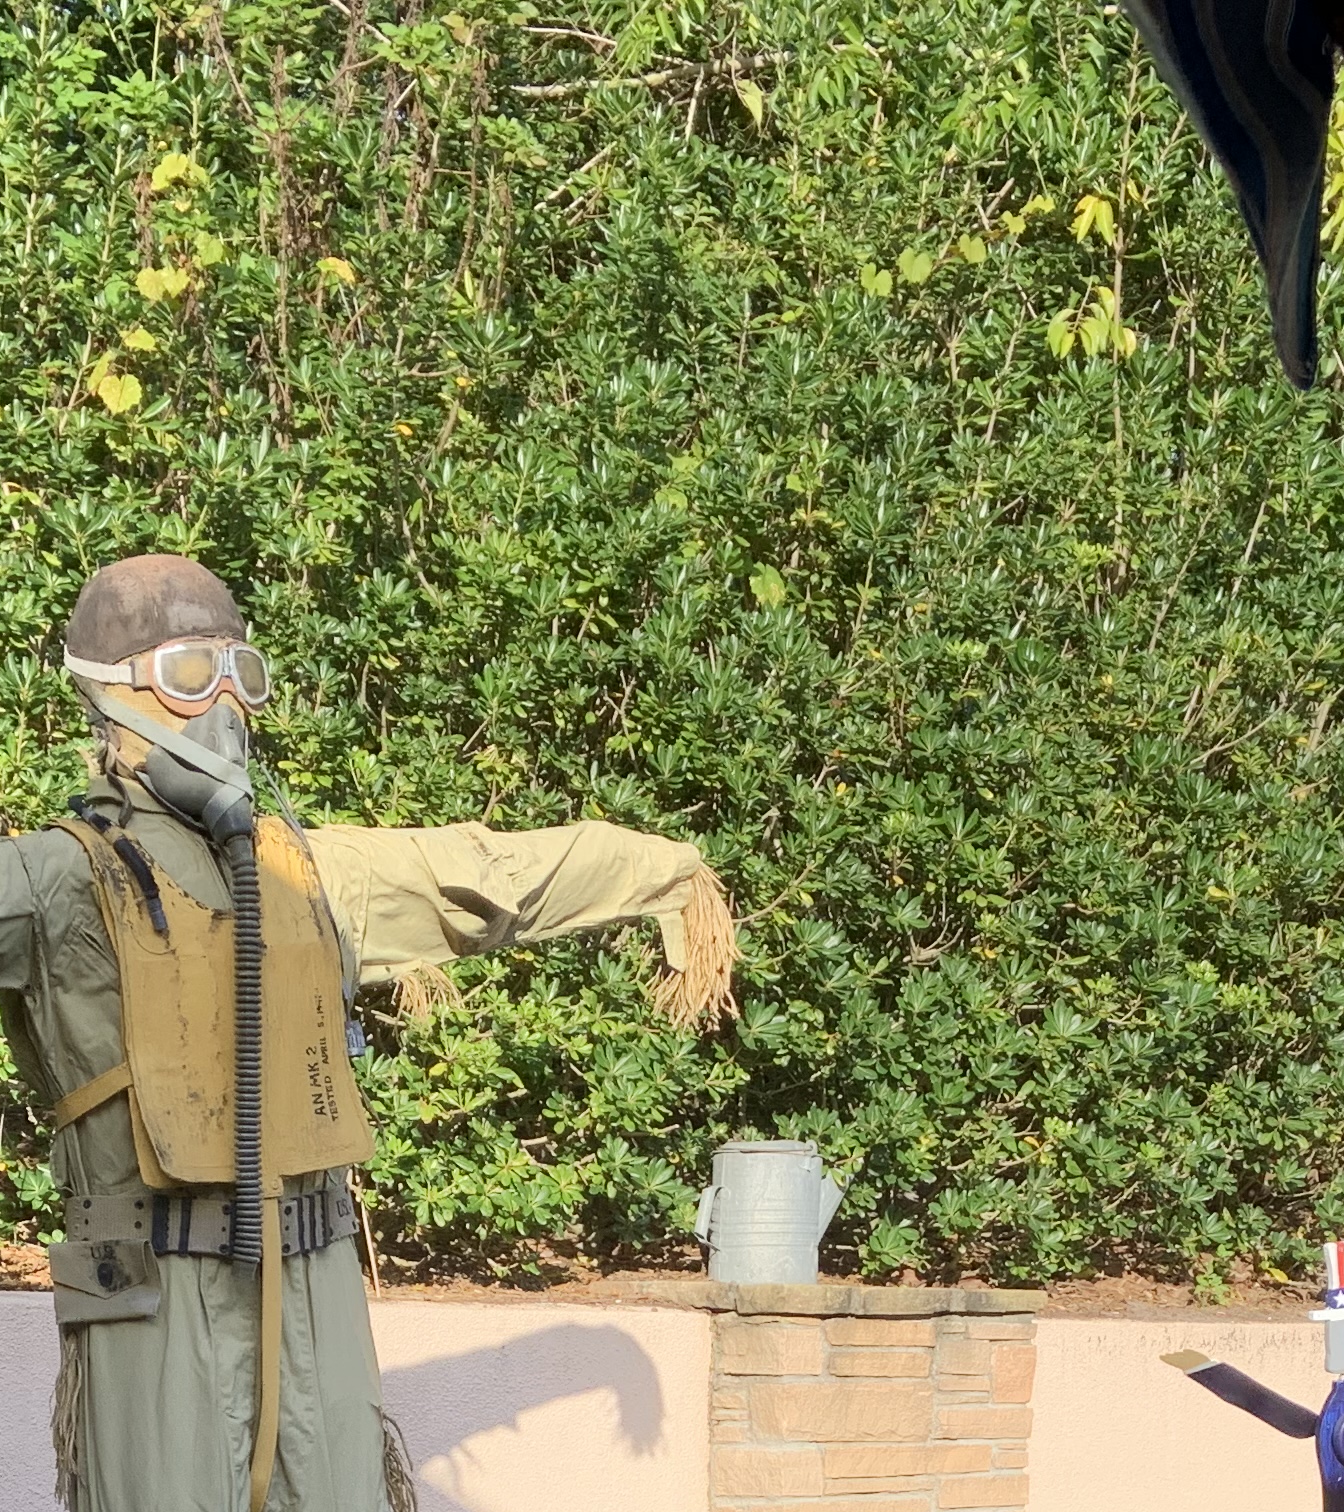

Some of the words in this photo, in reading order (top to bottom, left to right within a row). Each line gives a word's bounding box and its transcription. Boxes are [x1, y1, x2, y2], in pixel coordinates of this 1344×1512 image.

[306, 1046, 317, 1058] 2
[319, 1036, 330, 1065] APRIL
[312, 1092, 328, 1117] AN
[325, 1075, 339, 1122] TESTED
